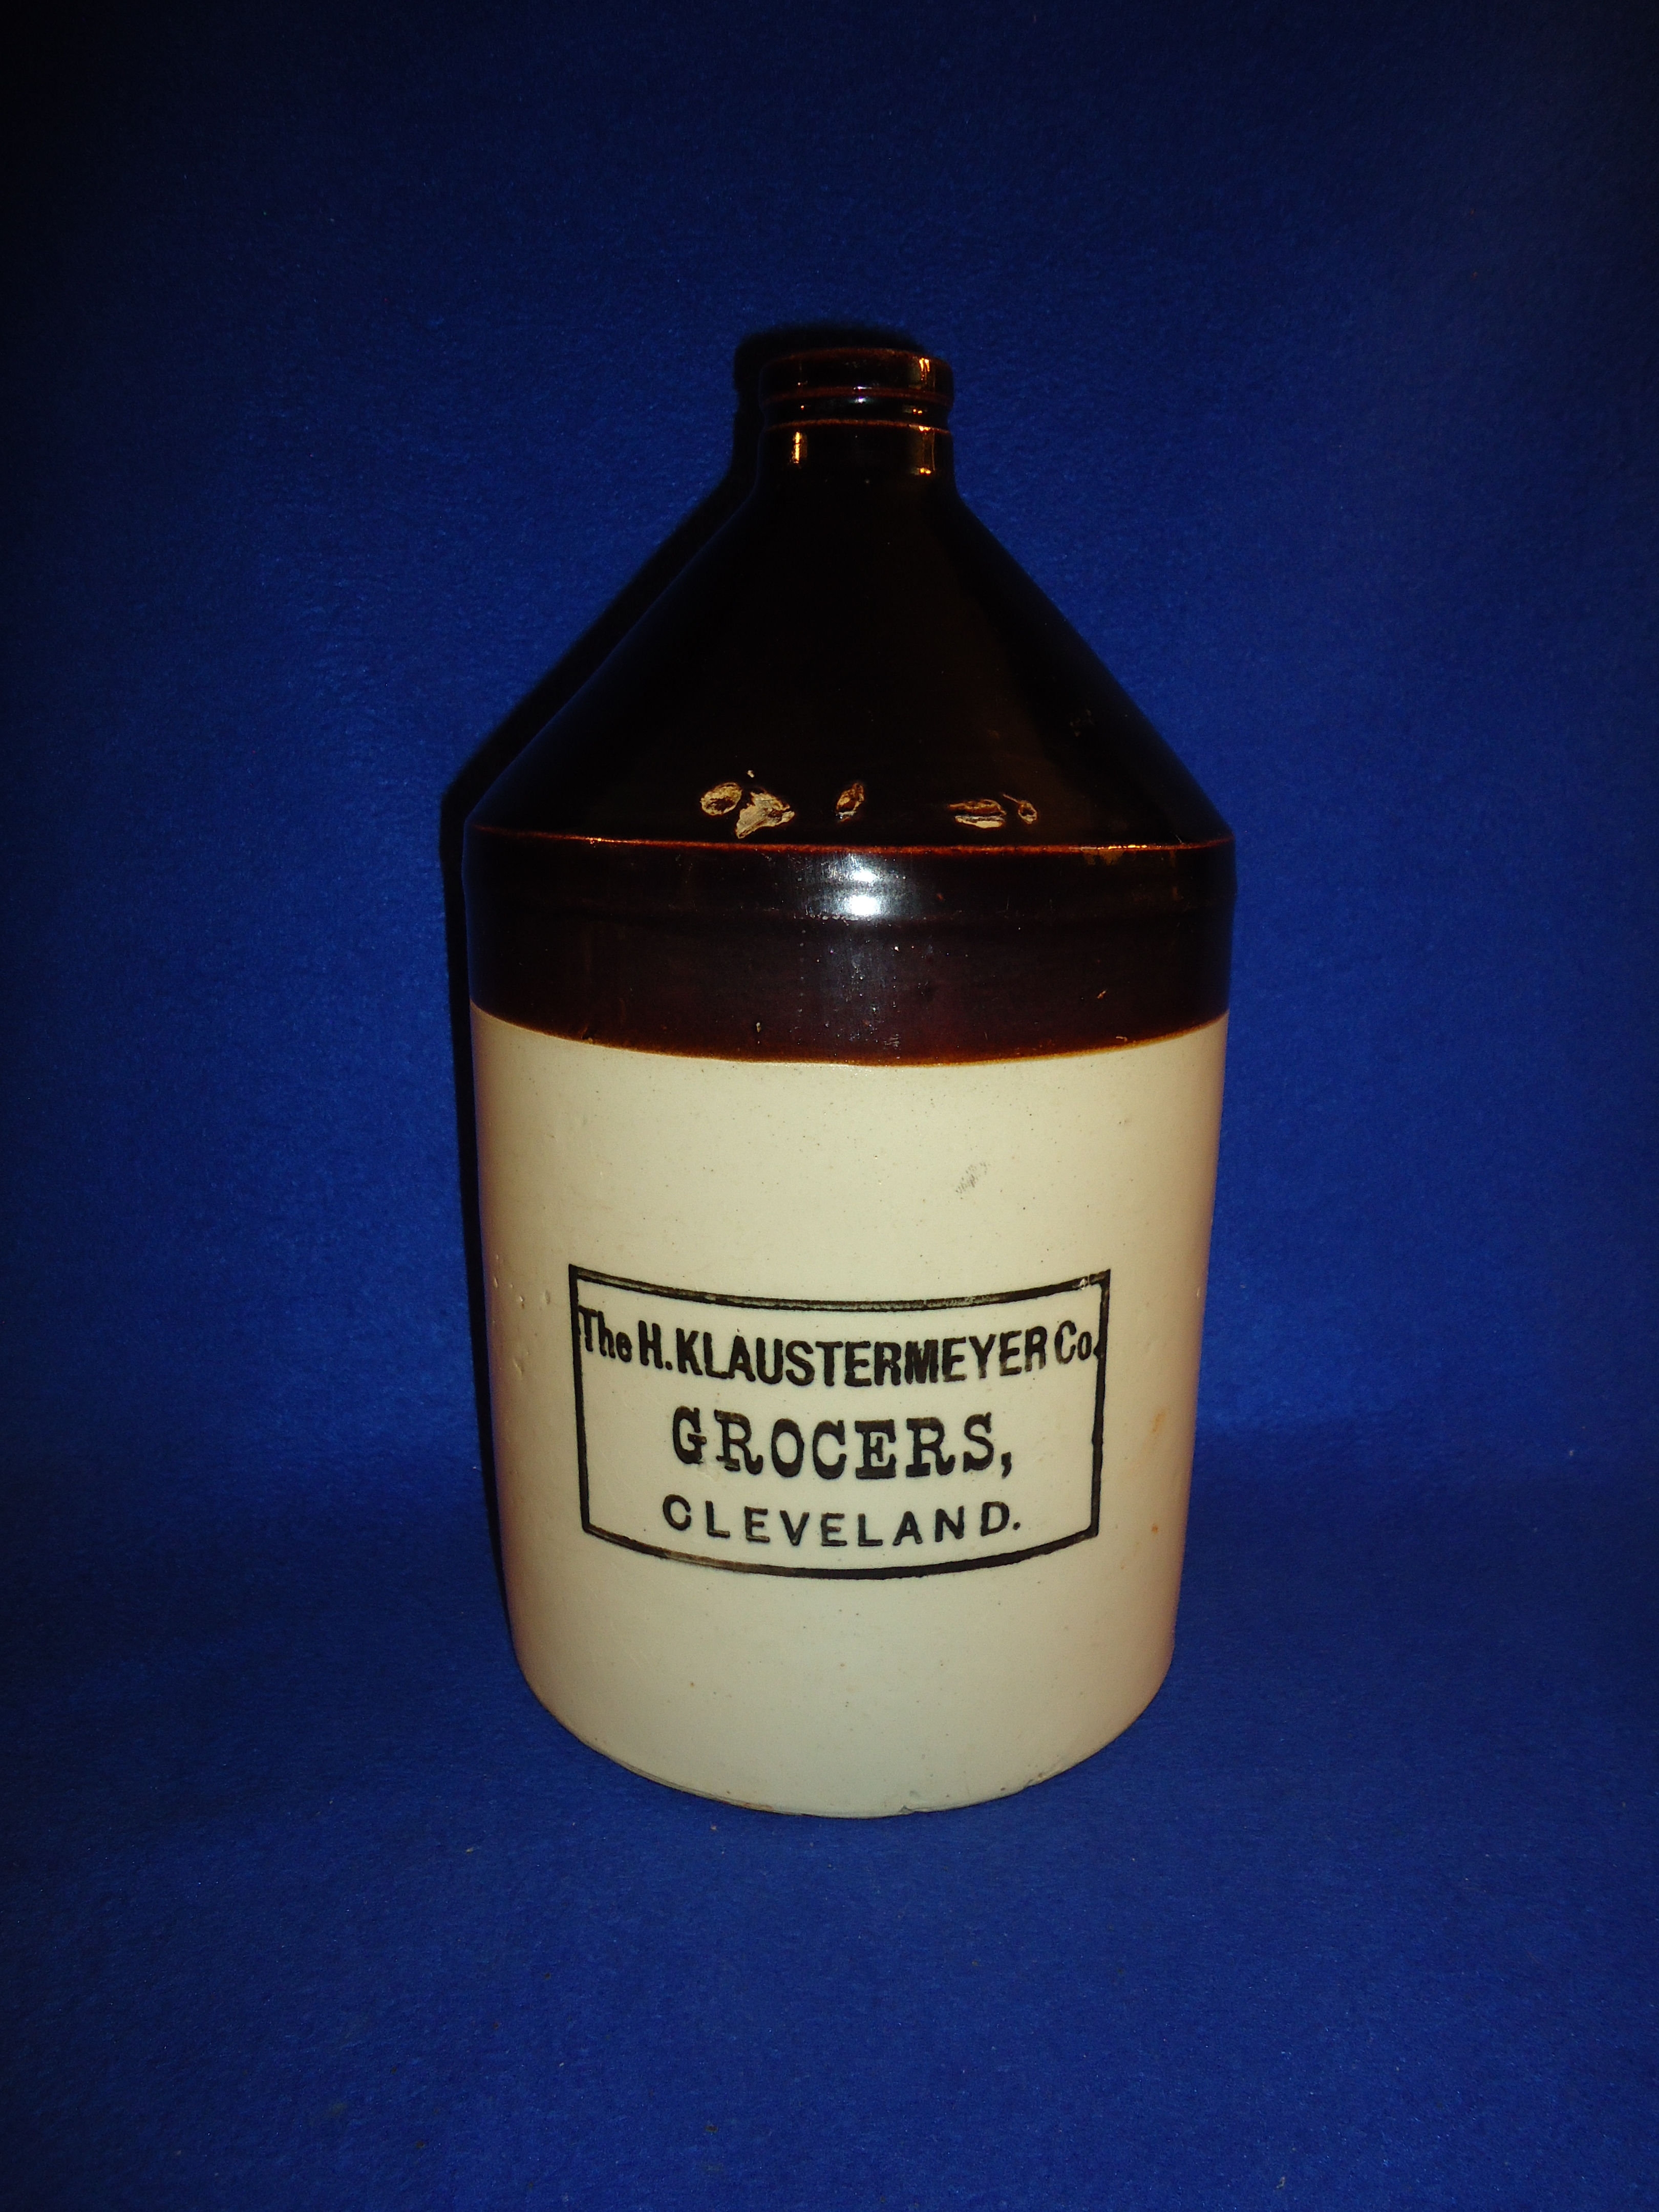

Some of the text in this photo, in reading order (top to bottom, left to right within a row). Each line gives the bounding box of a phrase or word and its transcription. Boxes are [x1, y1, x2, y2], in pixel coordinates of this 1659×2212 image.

[578, 1305, 633, 1363] The
[672, 1406, 1013, 1479] GROCERS,
[662, 1494, 1022, 1547] CLEVELAND.
